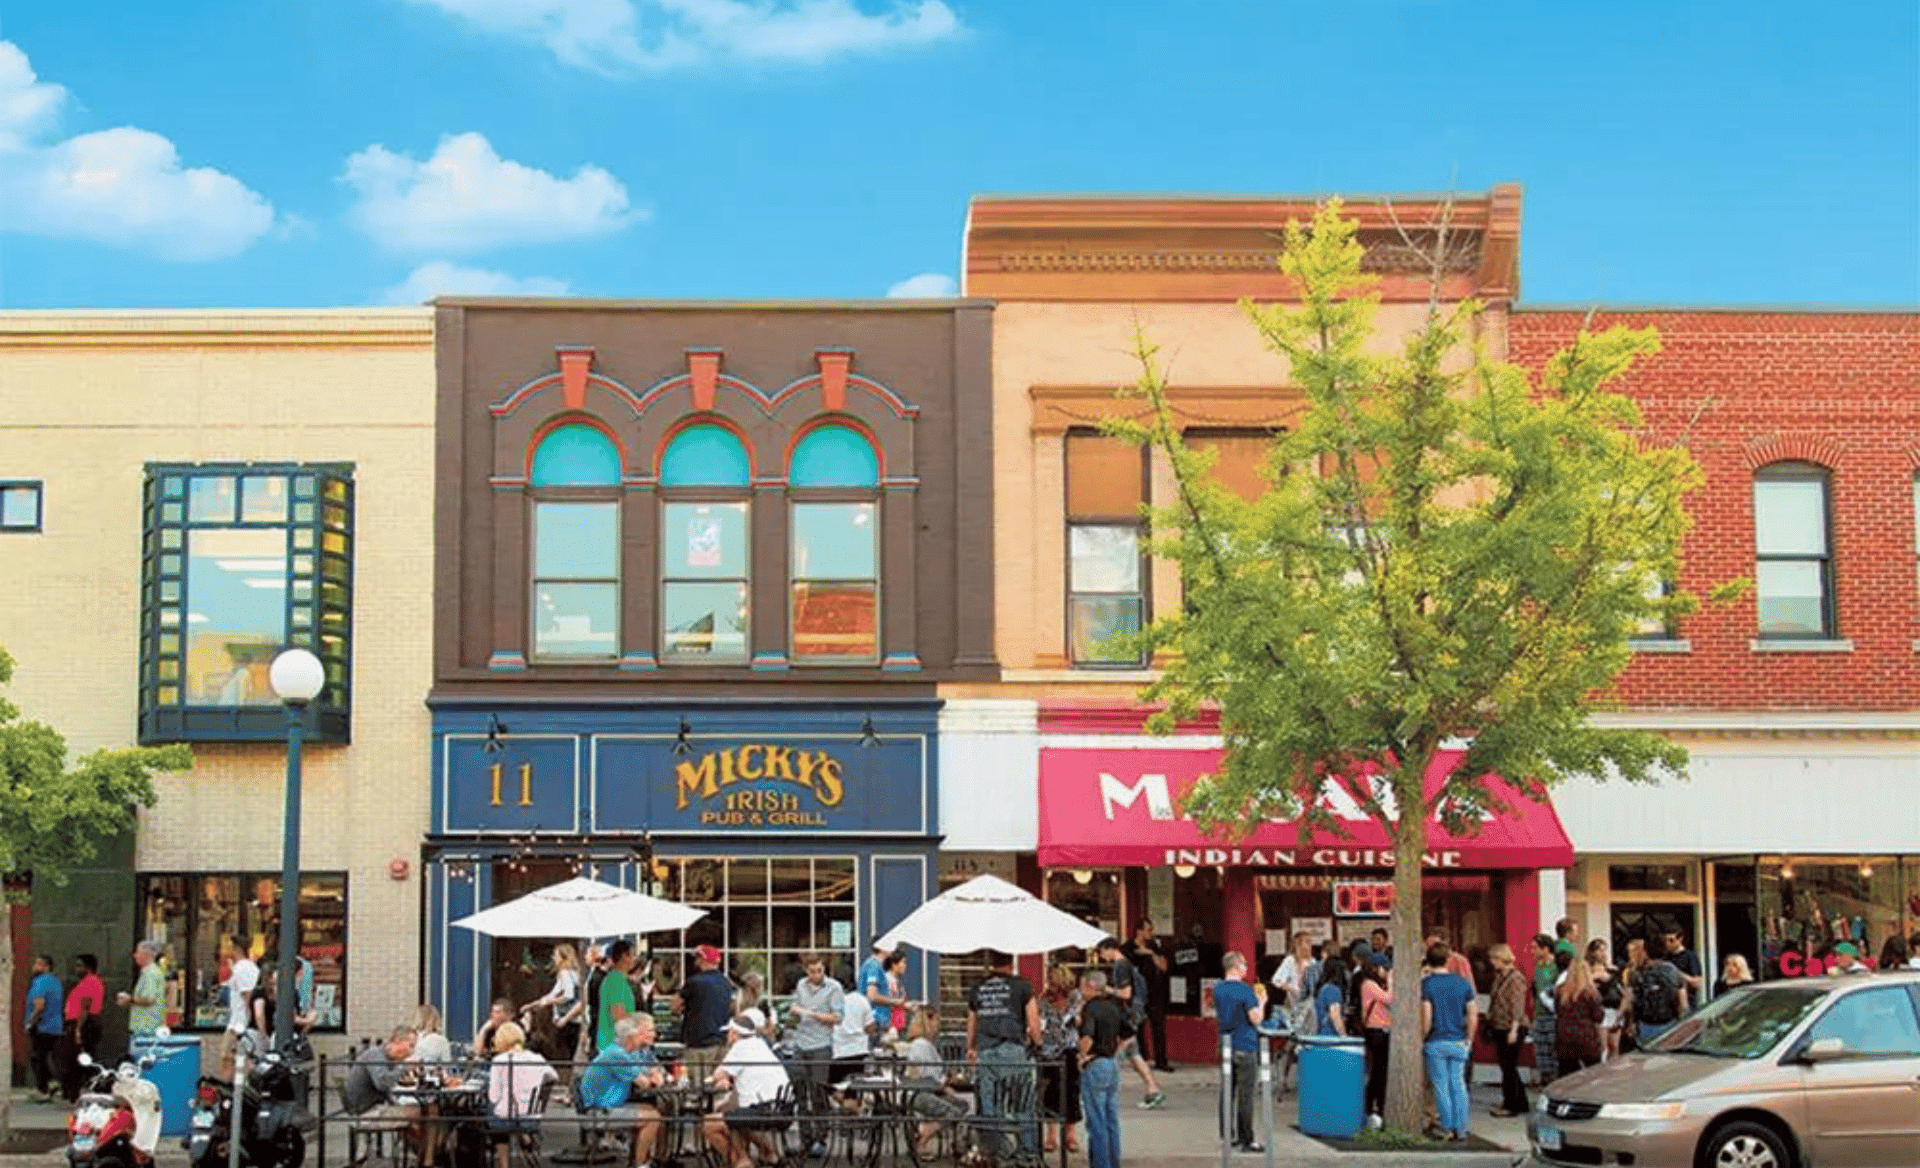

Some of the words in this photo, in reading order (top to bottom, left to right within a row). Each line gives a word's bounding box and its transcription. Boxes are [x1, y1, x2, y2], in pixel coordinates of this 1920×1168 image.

[488, 762, 534, 806] 11
[727, 789, 798, 811] IRISH
[701, 812, 744, 825] PUB
[750, 812, 763, 825] &
[768, 812, 827, 825] GRILL
[1165, 849, 1296, 866] INDIAN
[1312, 850, 1461, 867] CUISNE
[1337, 884, 1394, 912] OPE
